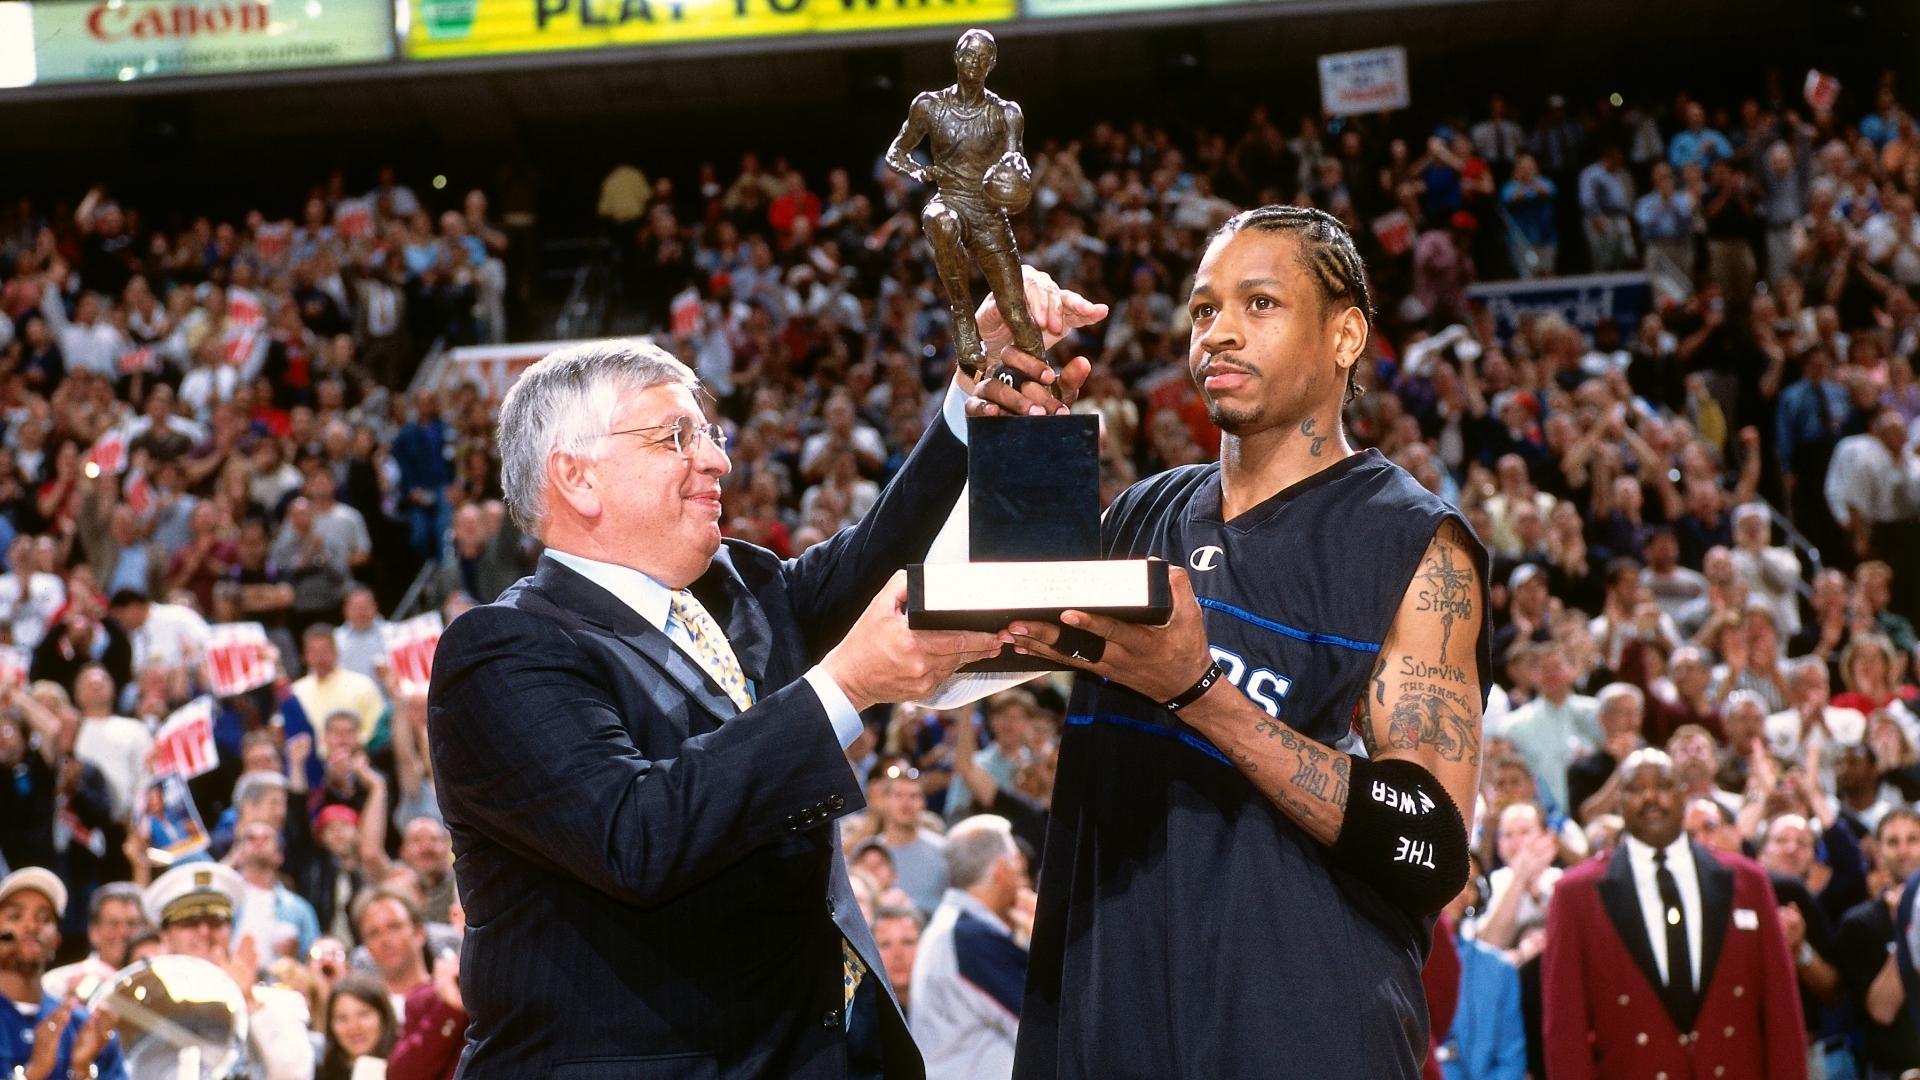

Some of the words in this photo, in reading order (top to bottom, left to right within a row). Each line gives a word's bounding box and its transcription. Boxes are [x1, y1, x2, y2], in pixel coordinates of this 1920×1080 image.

[86, 1, 269, 42] Canon
[1416, 590, 1472, 620] Strong
[1400, 682, 1426, 693] THE
[1394, 836, 1435, 869] THE
